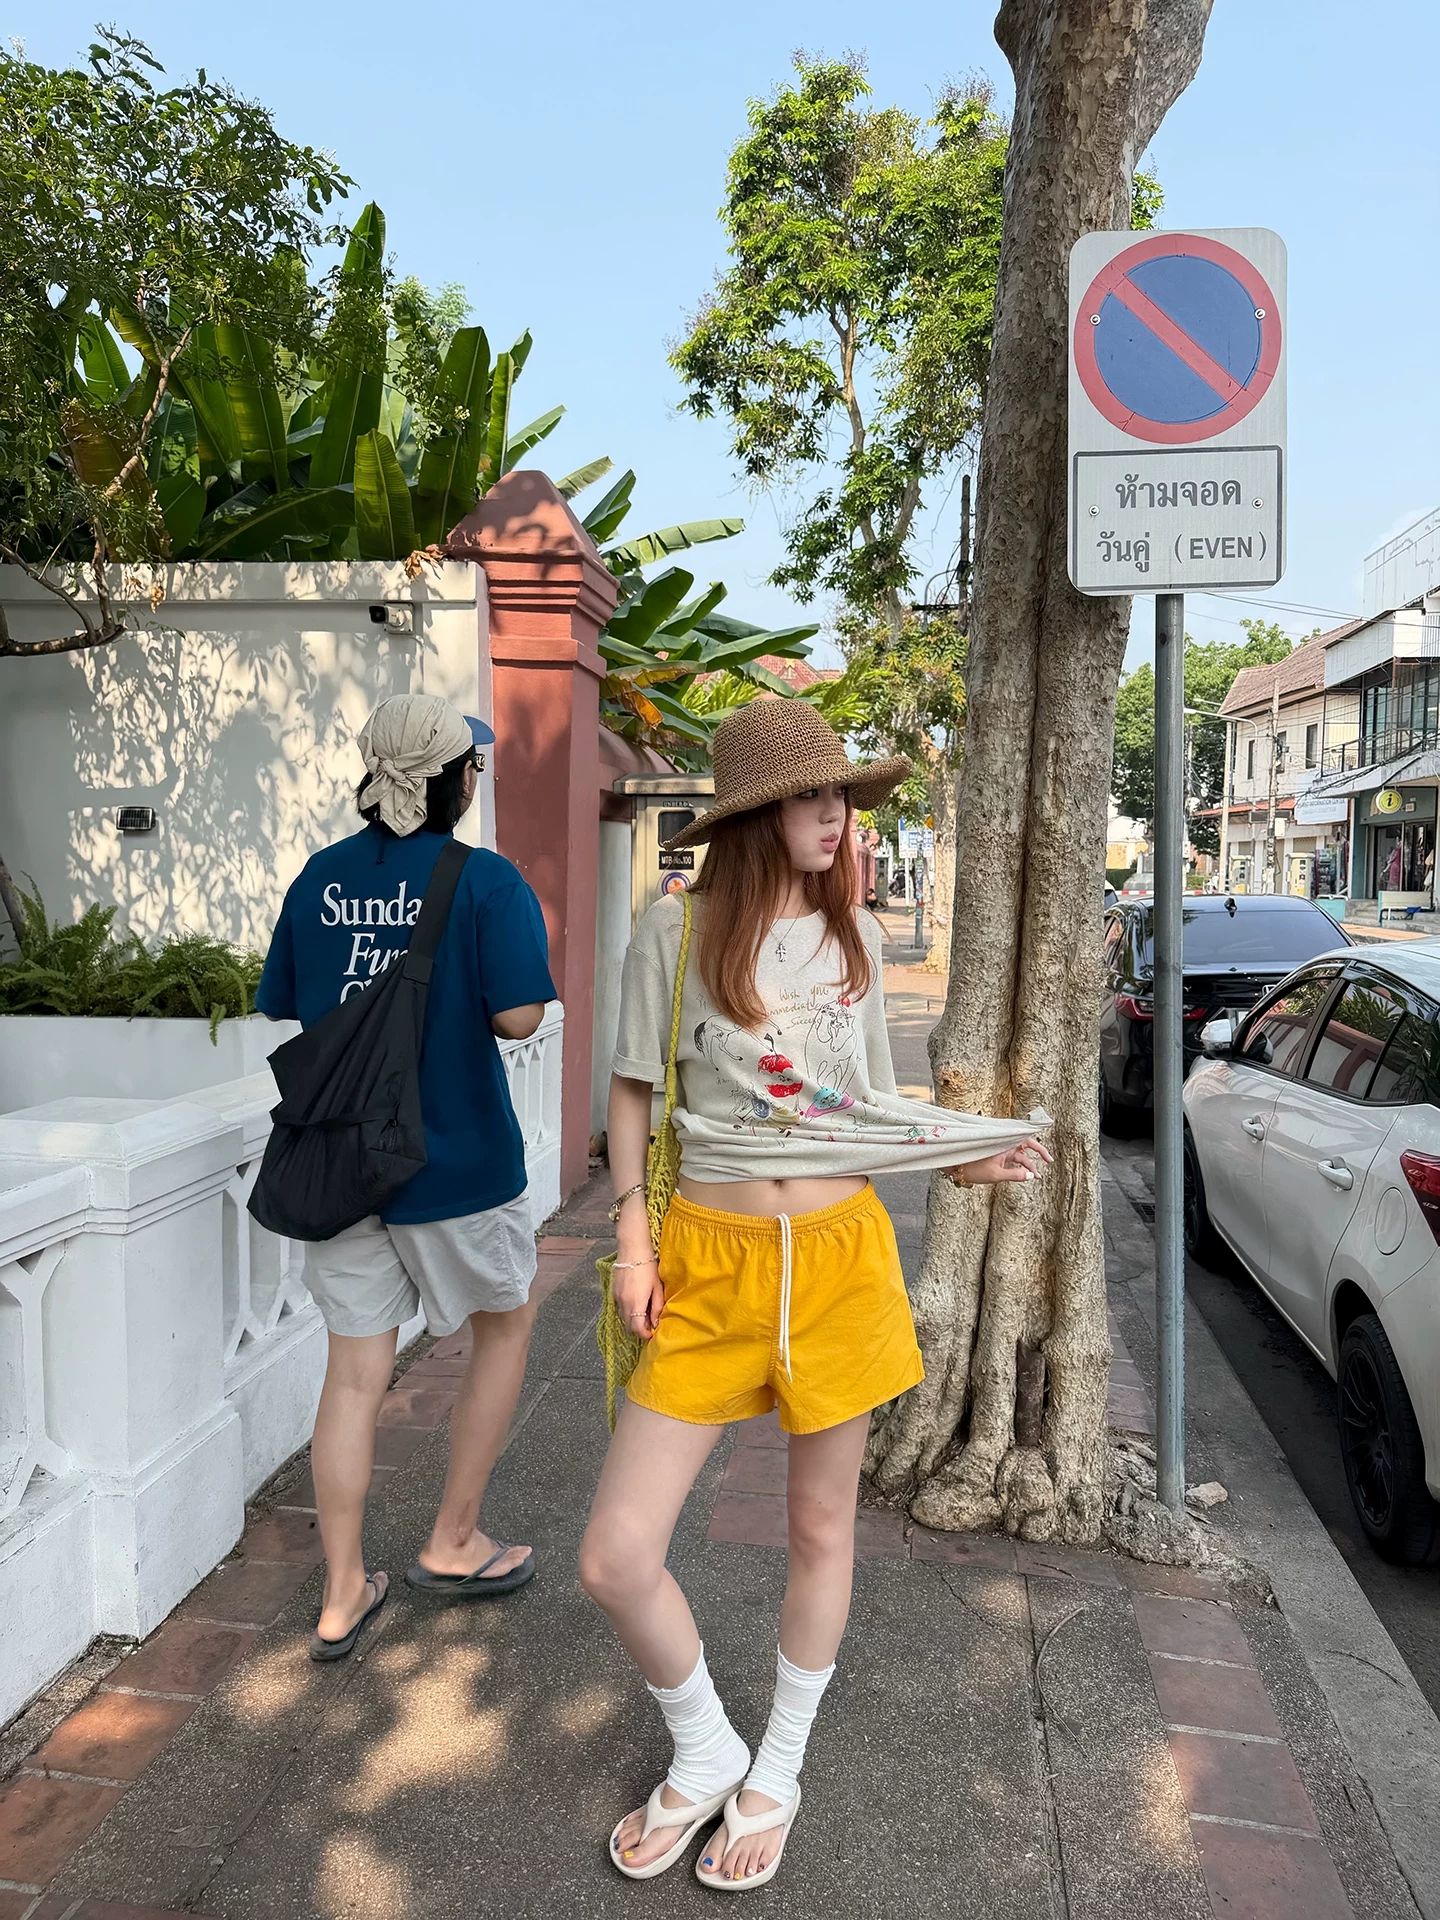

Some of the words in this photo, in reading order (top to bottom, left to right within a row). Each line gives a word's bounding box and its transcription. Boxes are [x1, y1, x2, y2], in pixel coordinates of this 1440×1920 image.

[1115, 474, 1241, 509] ห้ามจอด
[1097, 531, 1150, 573] วันคู่
[320, 880, 425, 927] Sunda
